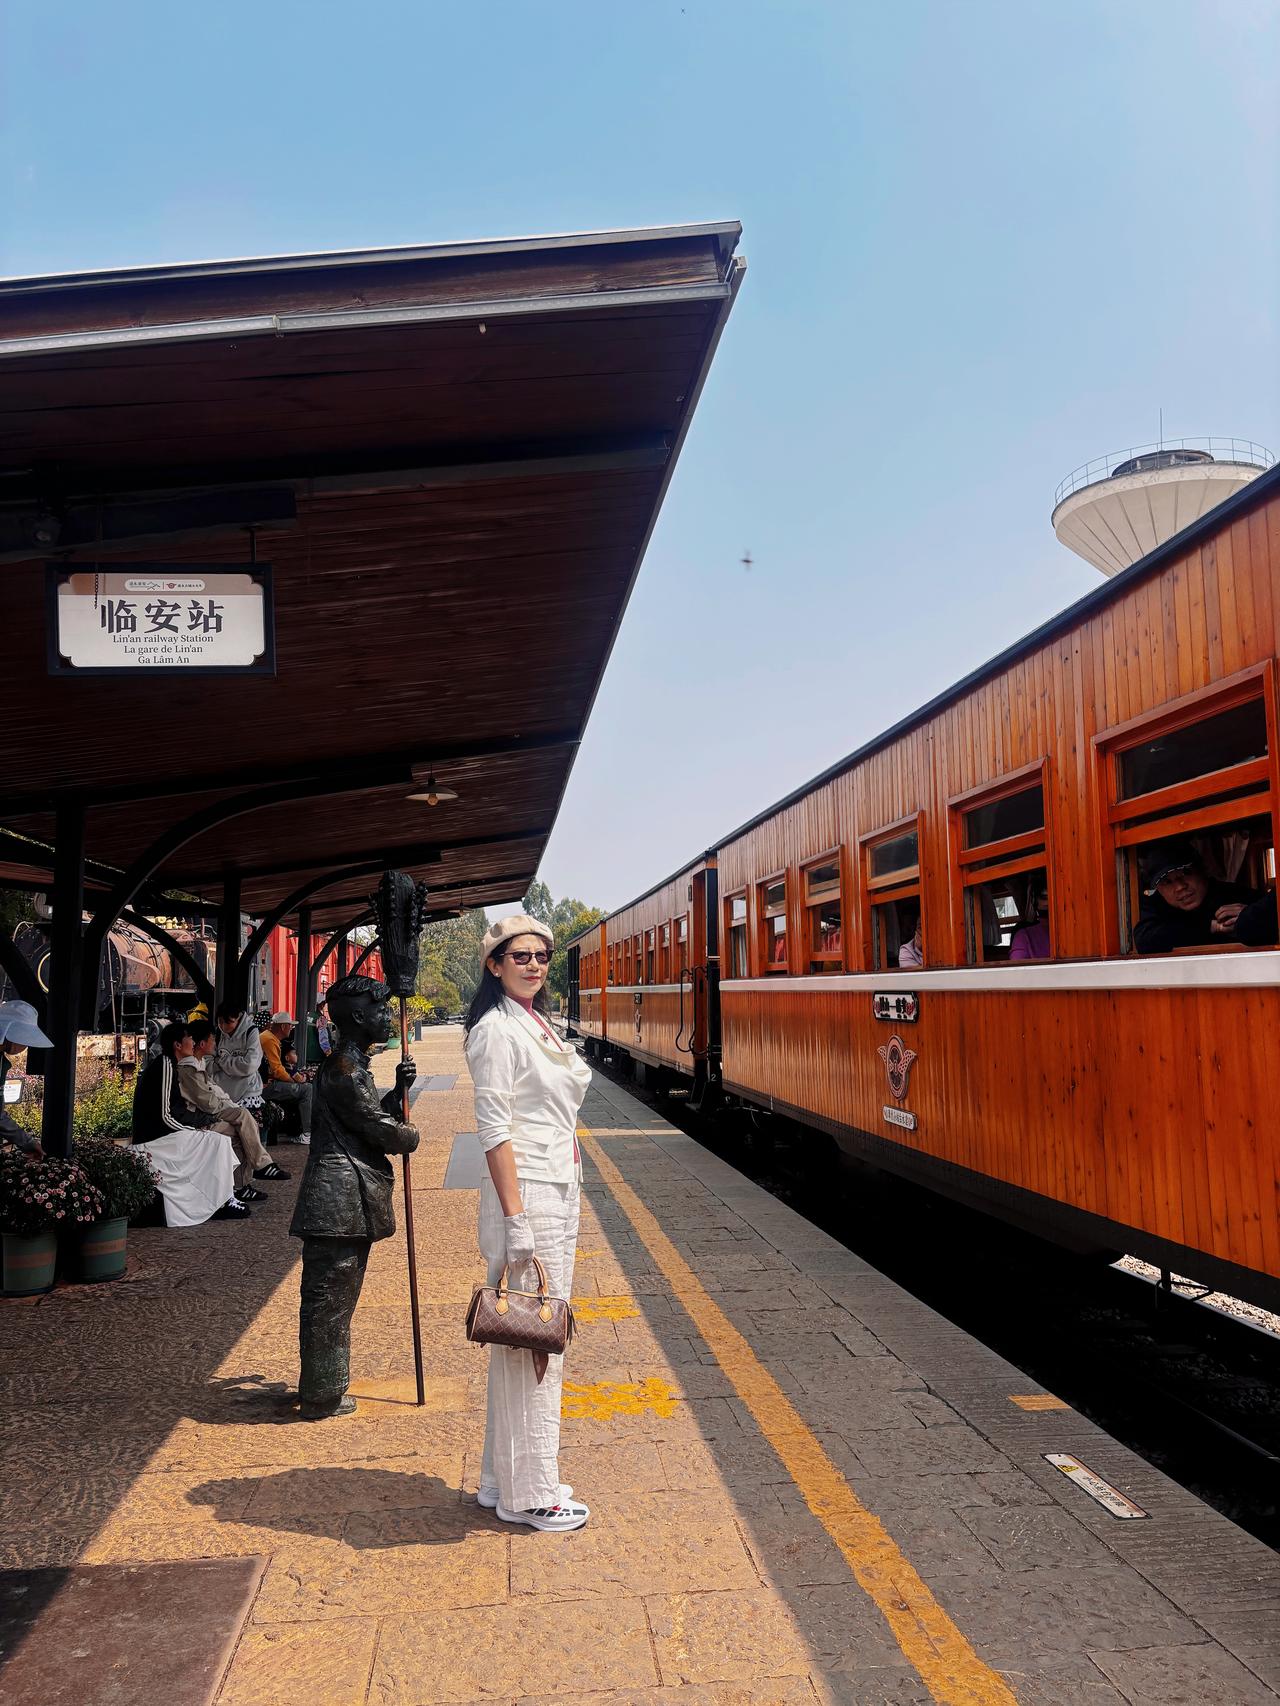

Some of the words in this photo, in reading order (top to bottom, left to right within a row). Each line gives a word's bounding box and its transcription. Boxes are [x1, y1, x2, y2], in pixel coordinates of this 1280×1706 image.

[101, 599, 224, 634] 临安站
[113, 634, 141, 643] Lin'an
[144, 634, 178, 644] railway
[180, 634, 214, 643] Station
[124, 645, 136, 654] La
[138, 646, 159, 655] gare
[161, 645, 173, 653] de
[175, 645, 203, 653] Lin'an
[138, 656, 151, 664] Ga
[176, 656, 190, 664] An
